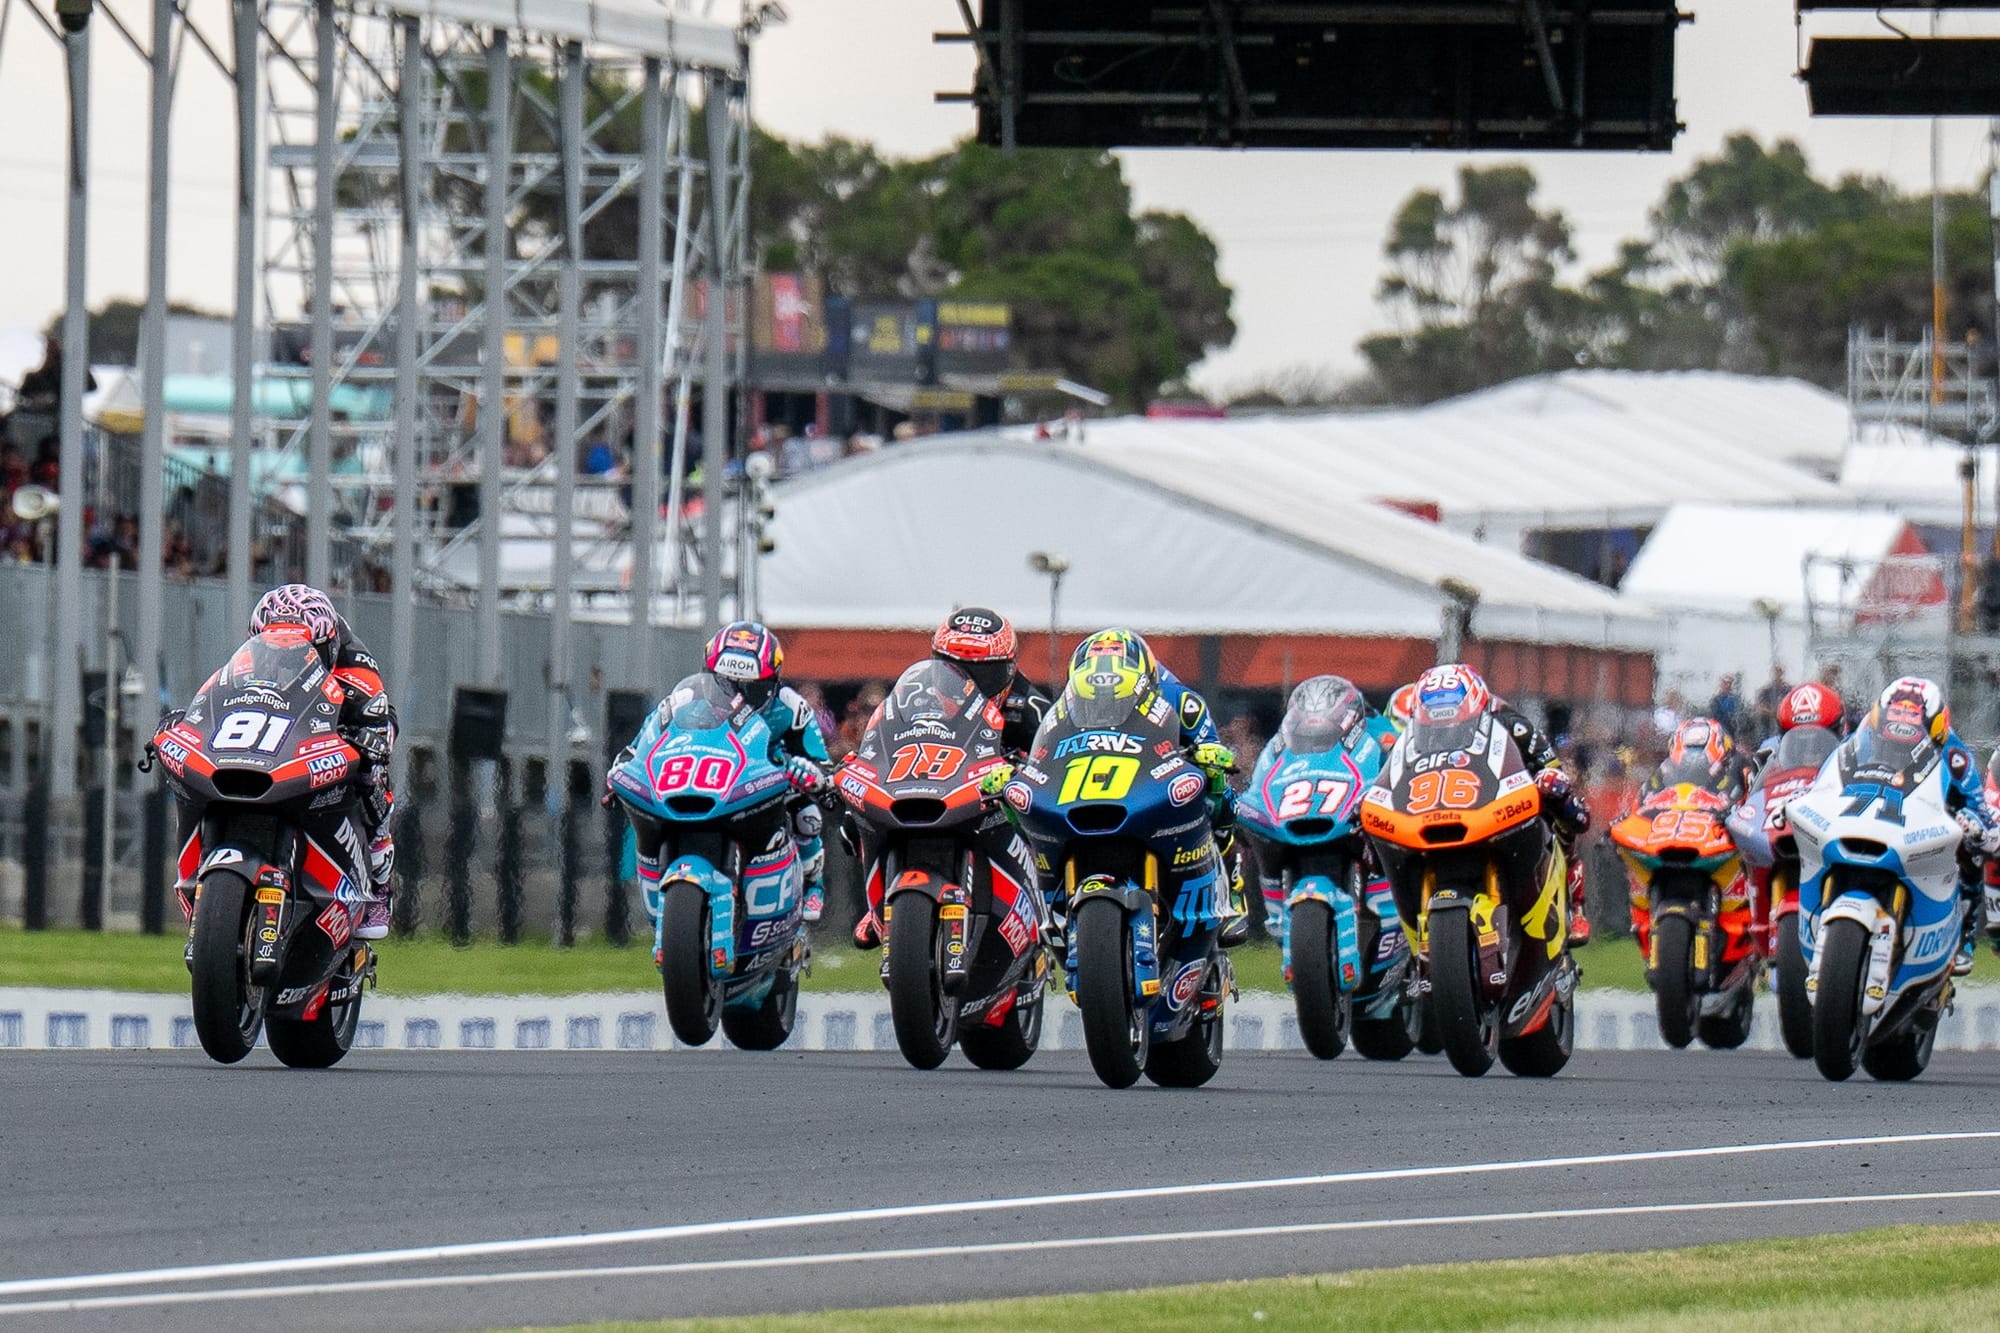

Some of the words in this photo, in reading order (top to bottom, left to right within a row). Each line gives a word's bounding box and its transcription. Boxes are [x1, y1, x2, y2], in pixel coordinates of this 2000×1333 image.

[954, 616, 992, 628] OLED
[971, 625, 982, 633] LG
[719, 658, 754, 672] AIROH
[1424, 674, 1461, 692] 96
[223, 693, 290, 712] Landgeflügel
[1431, 708, 1455, 718] SHOEI
[172, 727, 200, 744] LS2
[210, 709, 294, 755] 81
[894, 726, 956, 741] Landgeflügel
[1890, 724, 1914, 737] Arai
[161, 740, 189, 762] LIQUI
[299, 739, 339, 755] LS2
[308, 753, 346, 773] LIQUI
[885, 742, 967, 783] 18
[312, 766, 346, 787] MOLY
[656, 754, 734, 793] 80
[1056, 754, 1142, 806] 10
[842, 776, 867, 797] LIQUI
[1175, 780, 1197, 799] PATA
[1406, 769, 1481, 814] 96
[1006, 788, 1026, 807] PATA
[1278, 780, 1350, 819] 27
[1839, 782, 1907, 828] 71
[1432, 812, 1461, 821] Beta
[1506, 799, 1533, 819] Beta
[1372, 816, 1395, 834] Beta
[1001, 913, 1030, 953] MOLY
